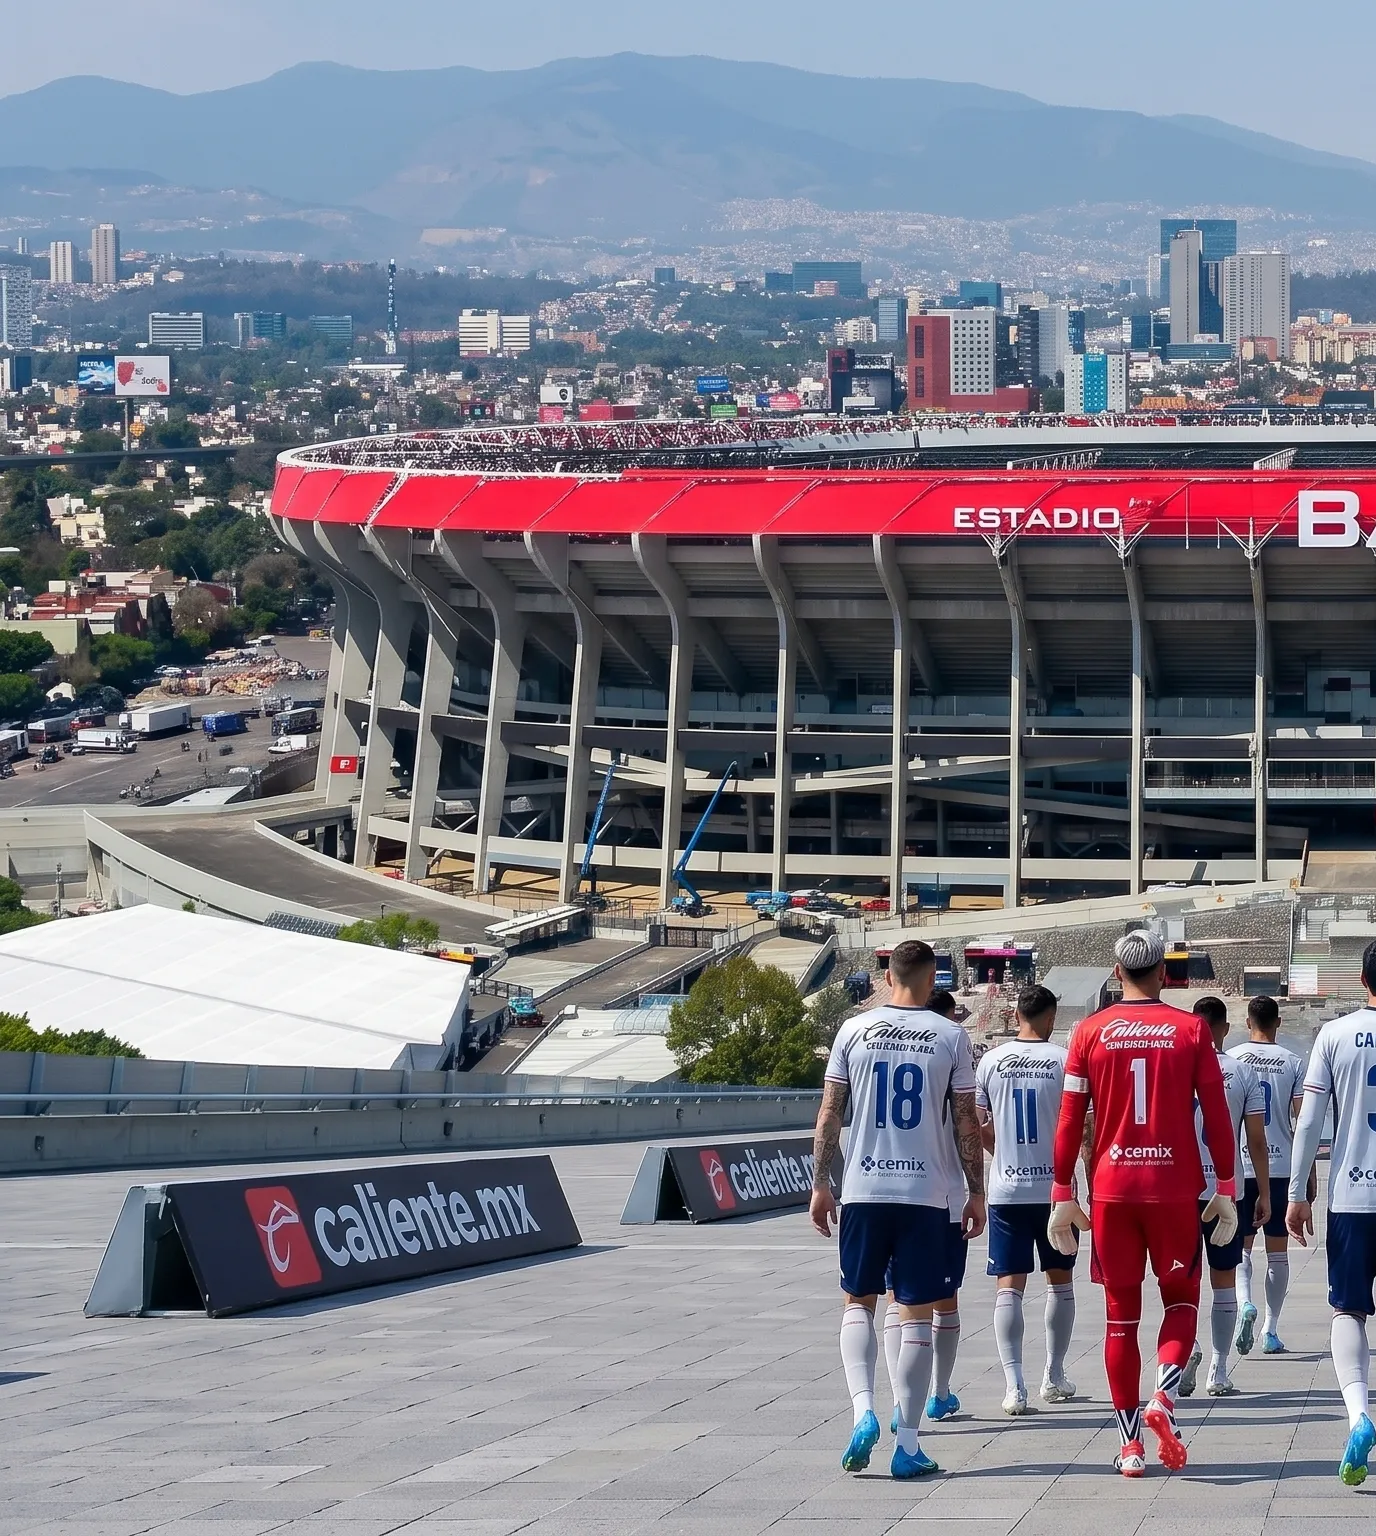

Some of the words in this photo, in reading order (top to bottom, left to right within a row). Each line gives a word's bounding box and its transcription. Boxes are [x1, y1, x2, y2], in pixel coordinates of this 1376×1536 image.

[954, 507, 1121, 529] ESTADIO
[872, 1061, 924, 1131] 18
[1012, 1088, 1038, 1145] 11
[1130, 1058, 1147, 1125] 1
[729, 1148, 836, 1201] caliente.m
[877, 1156, 926, 1172] cemix
[1016, 1163, 1055, 1176] cemix
[1124, 1143, 1173, 1158] cemix
[314, 1181, 541, 1267] caliente.mx
